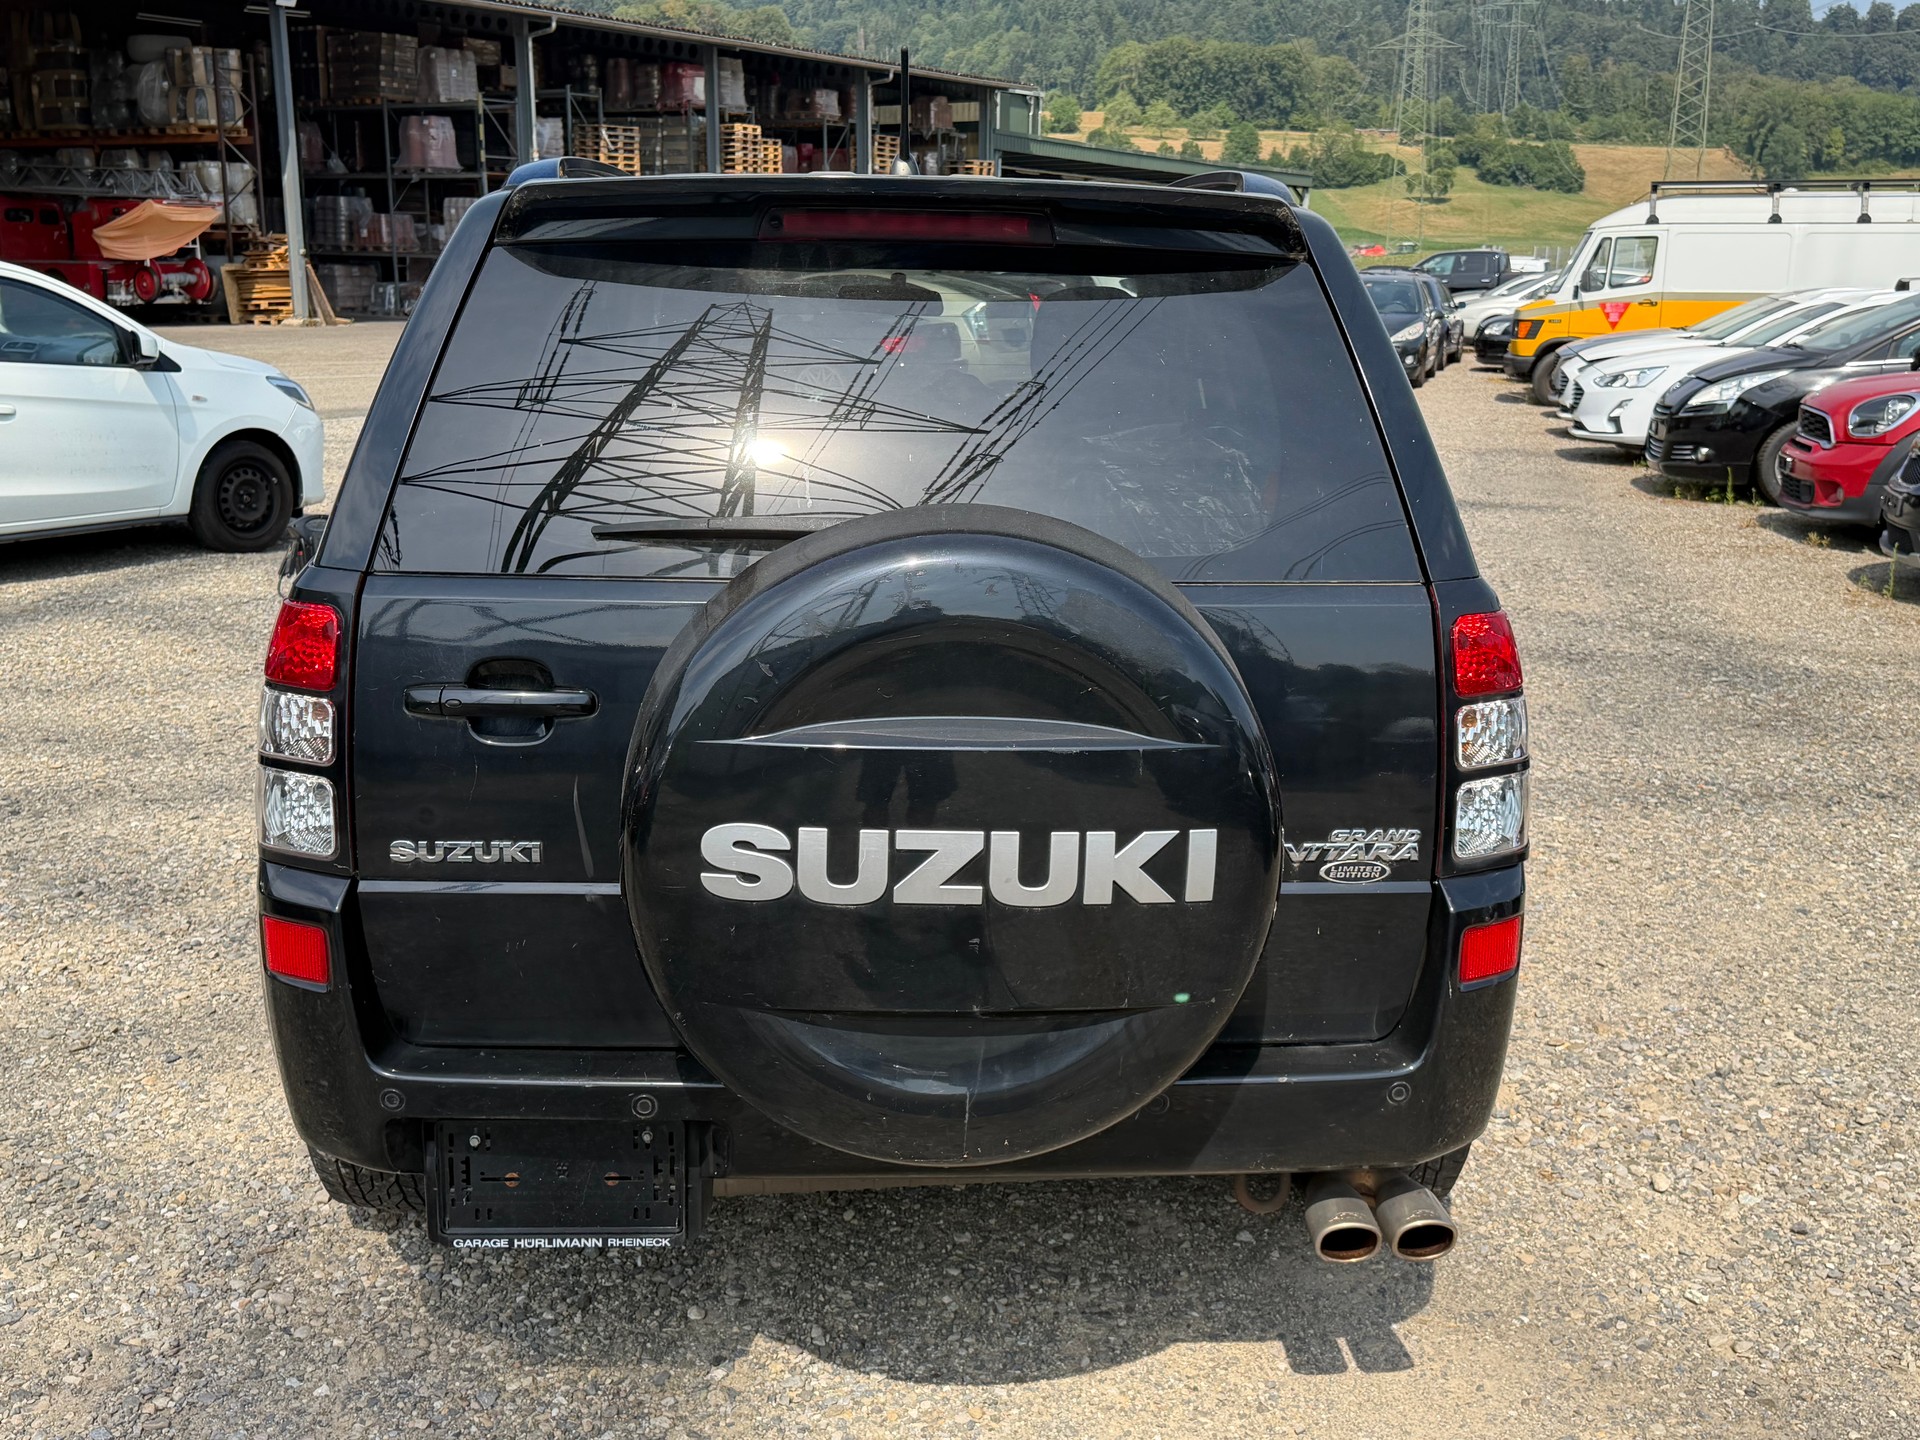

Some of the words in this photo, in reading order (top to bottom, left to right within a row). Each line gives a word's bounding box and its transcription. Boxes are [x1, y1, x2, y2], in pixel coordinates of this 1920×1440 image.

[1330, 829, 1421, 843] GRAND
[389, 840, 543, 863] SUZUKI
[1284, 842, 1419, 862] VITARA
[700, 822, 1218, 907] SUZUKI
[1330, 865, 1382, 873] LIMITED
[453, 1238, 509, 1248] GARAGE
[514, 1237, 603, 1248] HÜRLIMANN
[607, 1237, 671, 1248] RHEINECK
